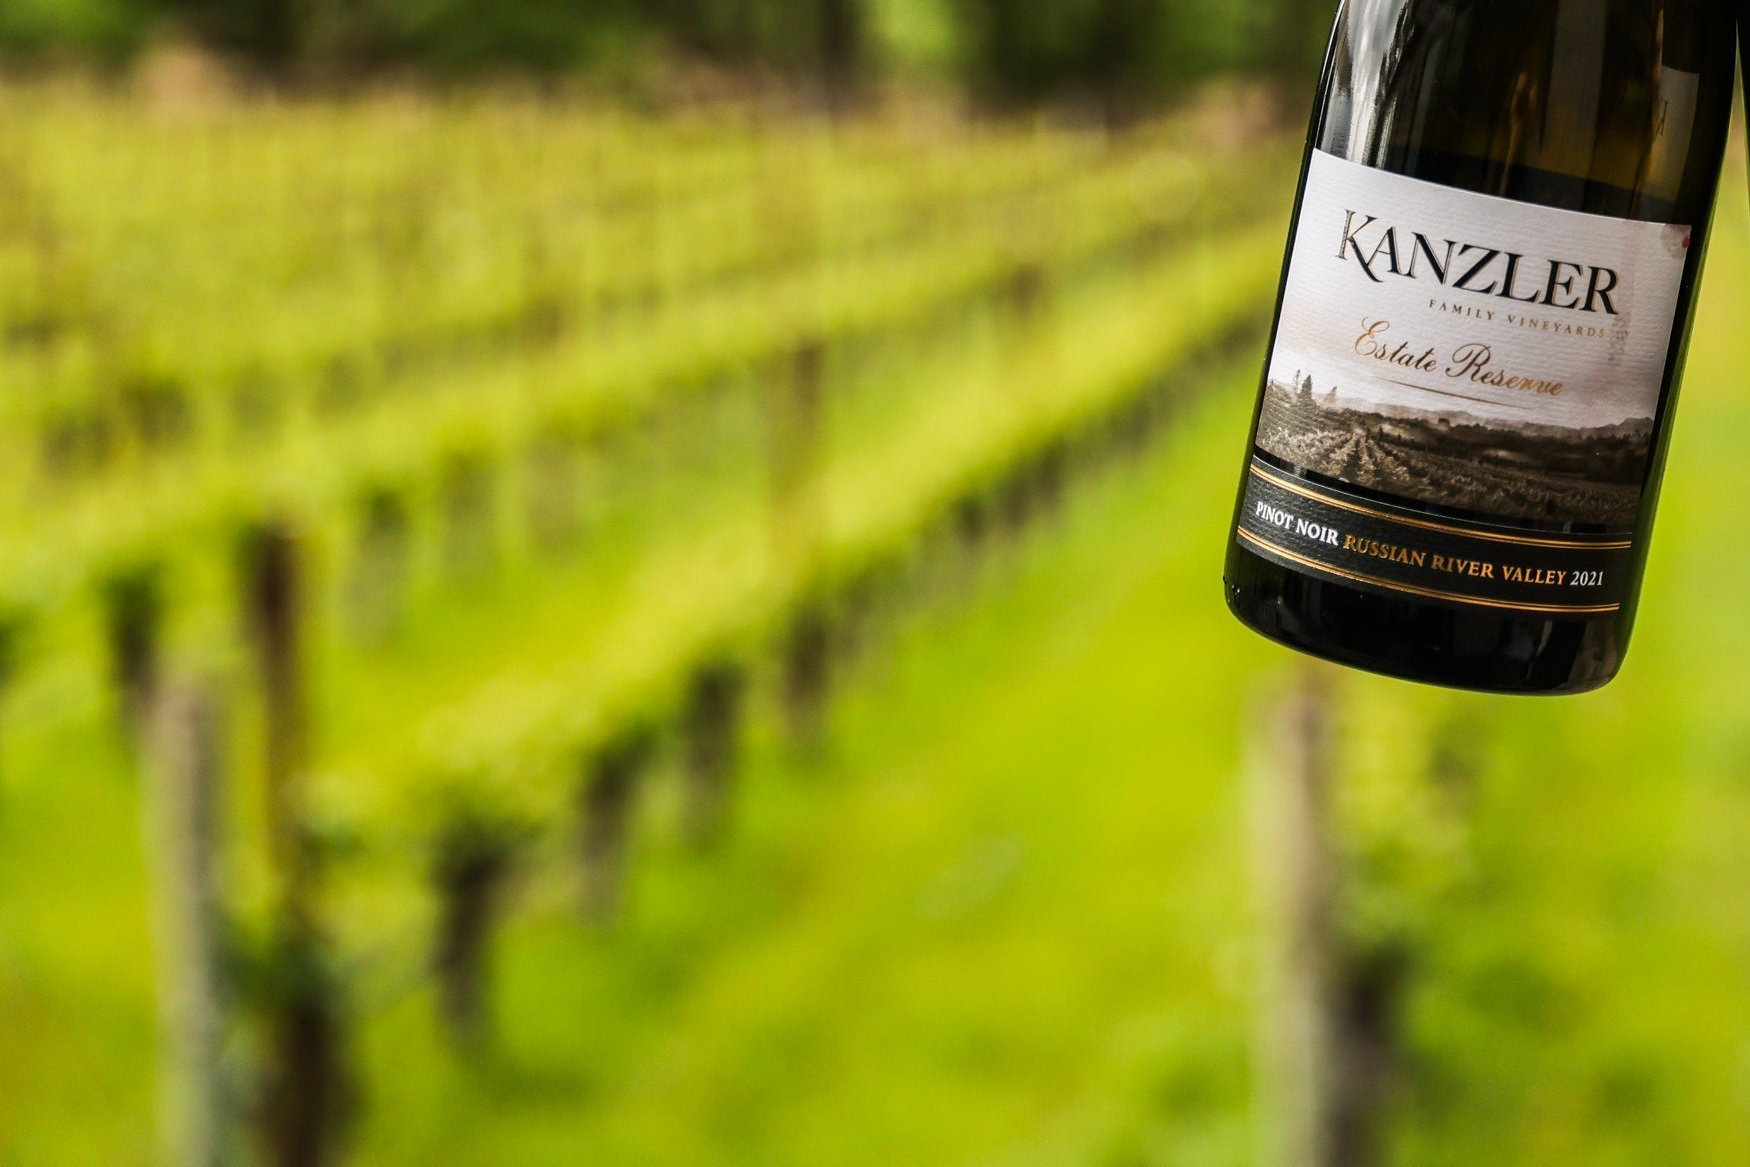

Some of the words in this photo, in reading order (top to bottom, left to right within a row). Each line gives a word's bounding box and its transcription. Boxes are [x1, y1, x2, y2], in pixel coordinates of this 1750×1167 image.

[1334, 209, 1620, 316] KANZLER
[1354, 316, 1437, 372] Estate
[1445, 342, 1563, 396] Reserve
[1429, 298, 1497, 321] FAMILY
[1507, 314, 1605, 339] VINEYARDS
[1255, 501, 1294, 530] PINOT
[1295, 518, 1339, 546] NOIR
[1342, 534, 1427, 568] RUSSIAN
[1431, 555, 1494, 579] RIVER
[1502, 565, 1567, 586] VALLEY
[1569, 571, 1604, 587] 2021
